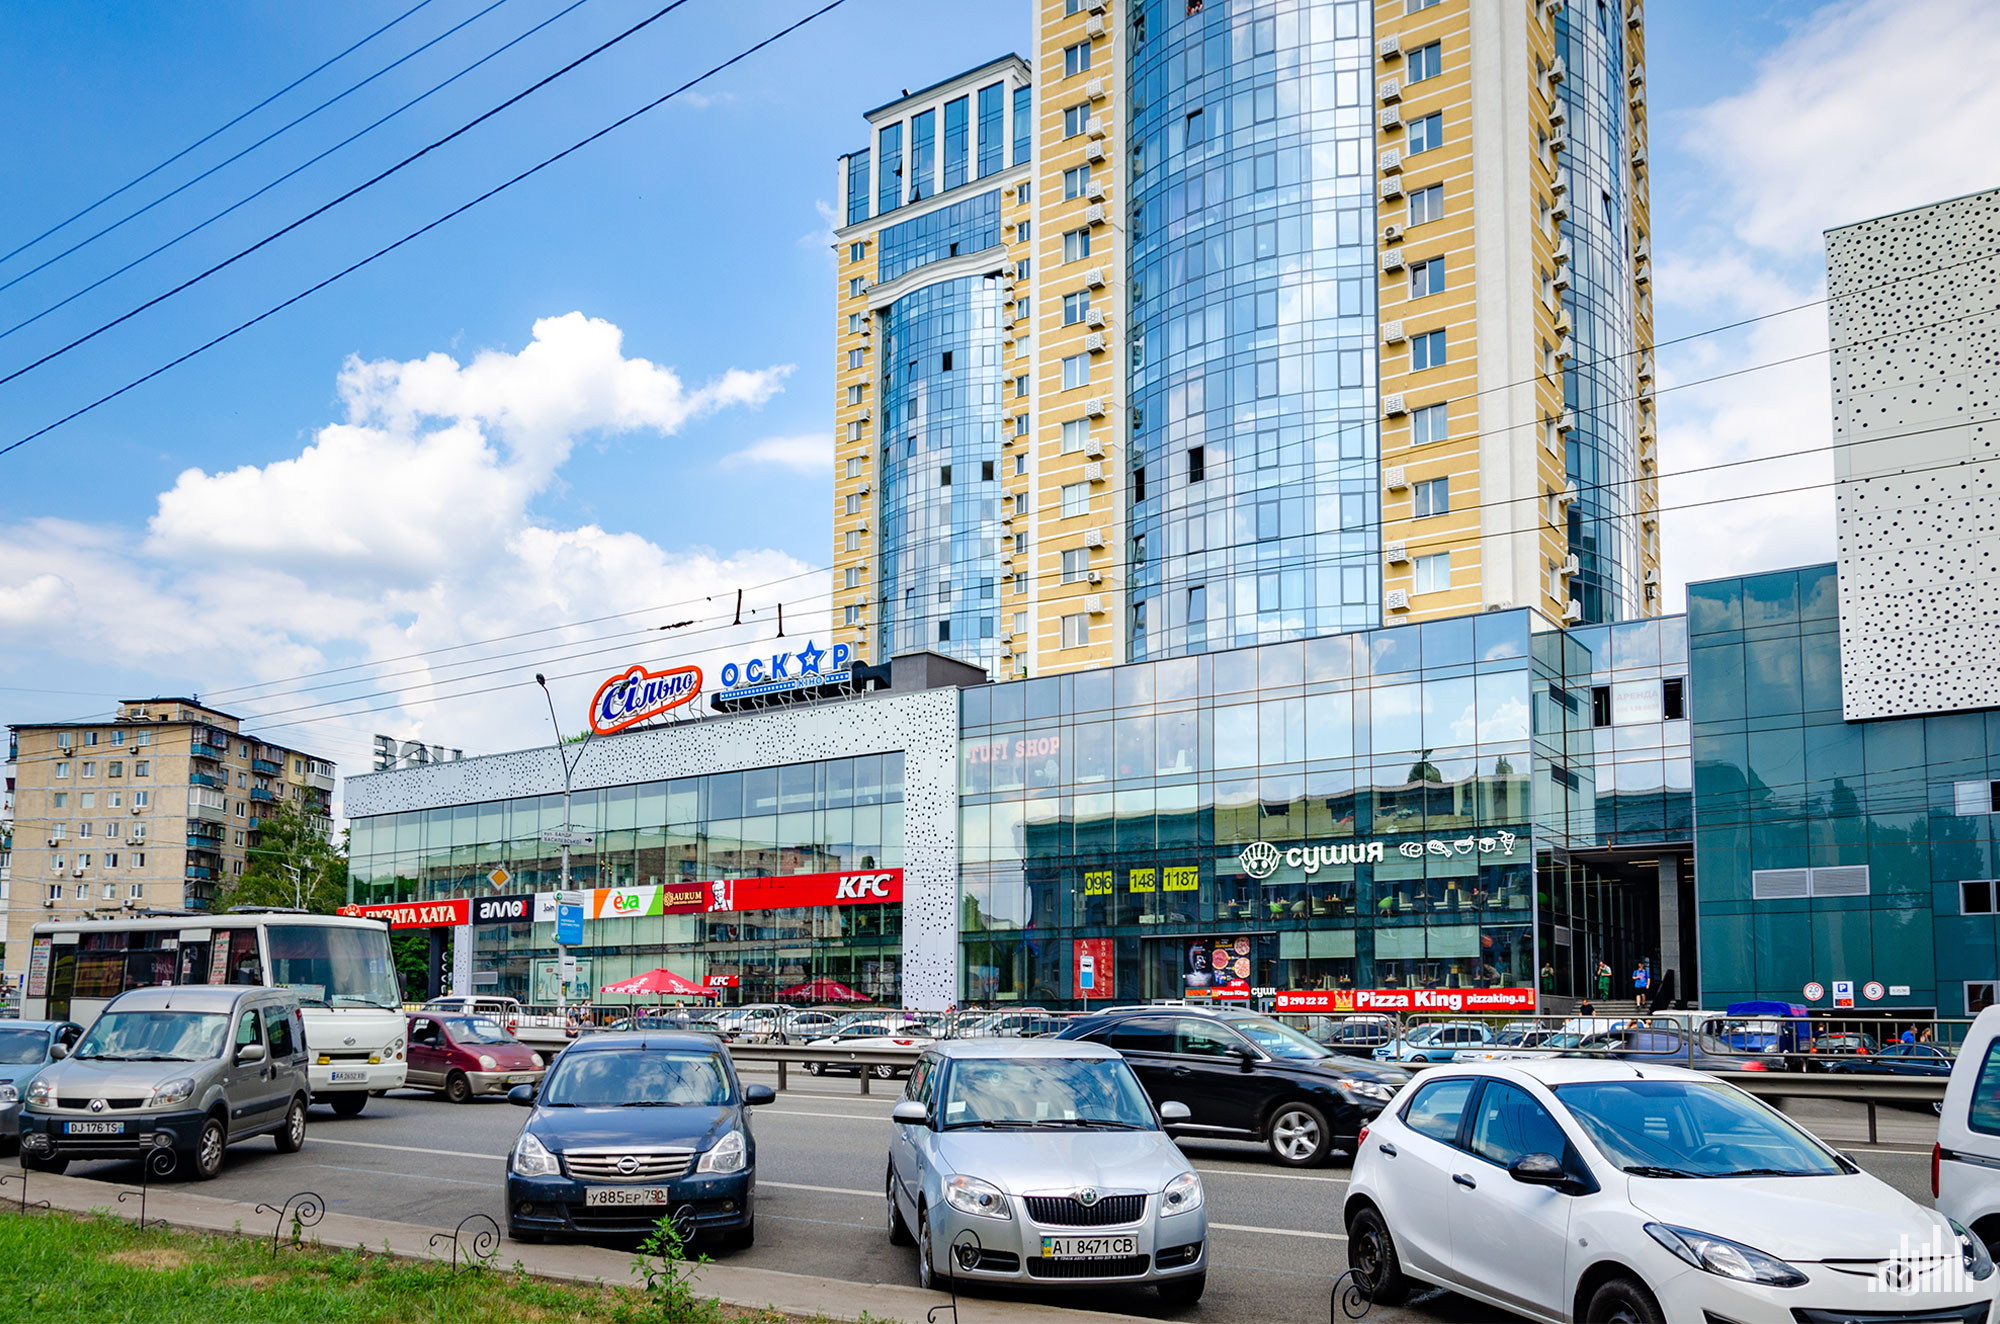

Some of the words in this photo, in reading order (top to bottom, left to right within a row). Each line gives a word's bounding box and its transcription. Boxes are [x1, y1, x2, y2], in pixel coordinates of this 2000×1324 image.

[969, 743, 1009, 764] TUFI
[1015, 736, 1060, 758] SHOP
[1286, 841, 1384, 874] сушия
[835, 873, 891, 899] KFC
[1085, 876, 1112, 891] 096
[1131, 873, 1155, 889] 148
[1164, 871, 1198, 887] 1187
[674, 891, 702, 901] AURUM
[419, 905, 456, 924] ХАТА
[709, 976, 730, 986] KFC
[1289, 996, 1305, 1006] 290
[1306, 996, 1317, 1006] 22
[1317, 996, 1329, 1006] 22
[1356, 991, 1409, 1008] Pizza
[1414, 990, 1462, 1011] King
[1077, 1239, 1109, 1254] 8471
